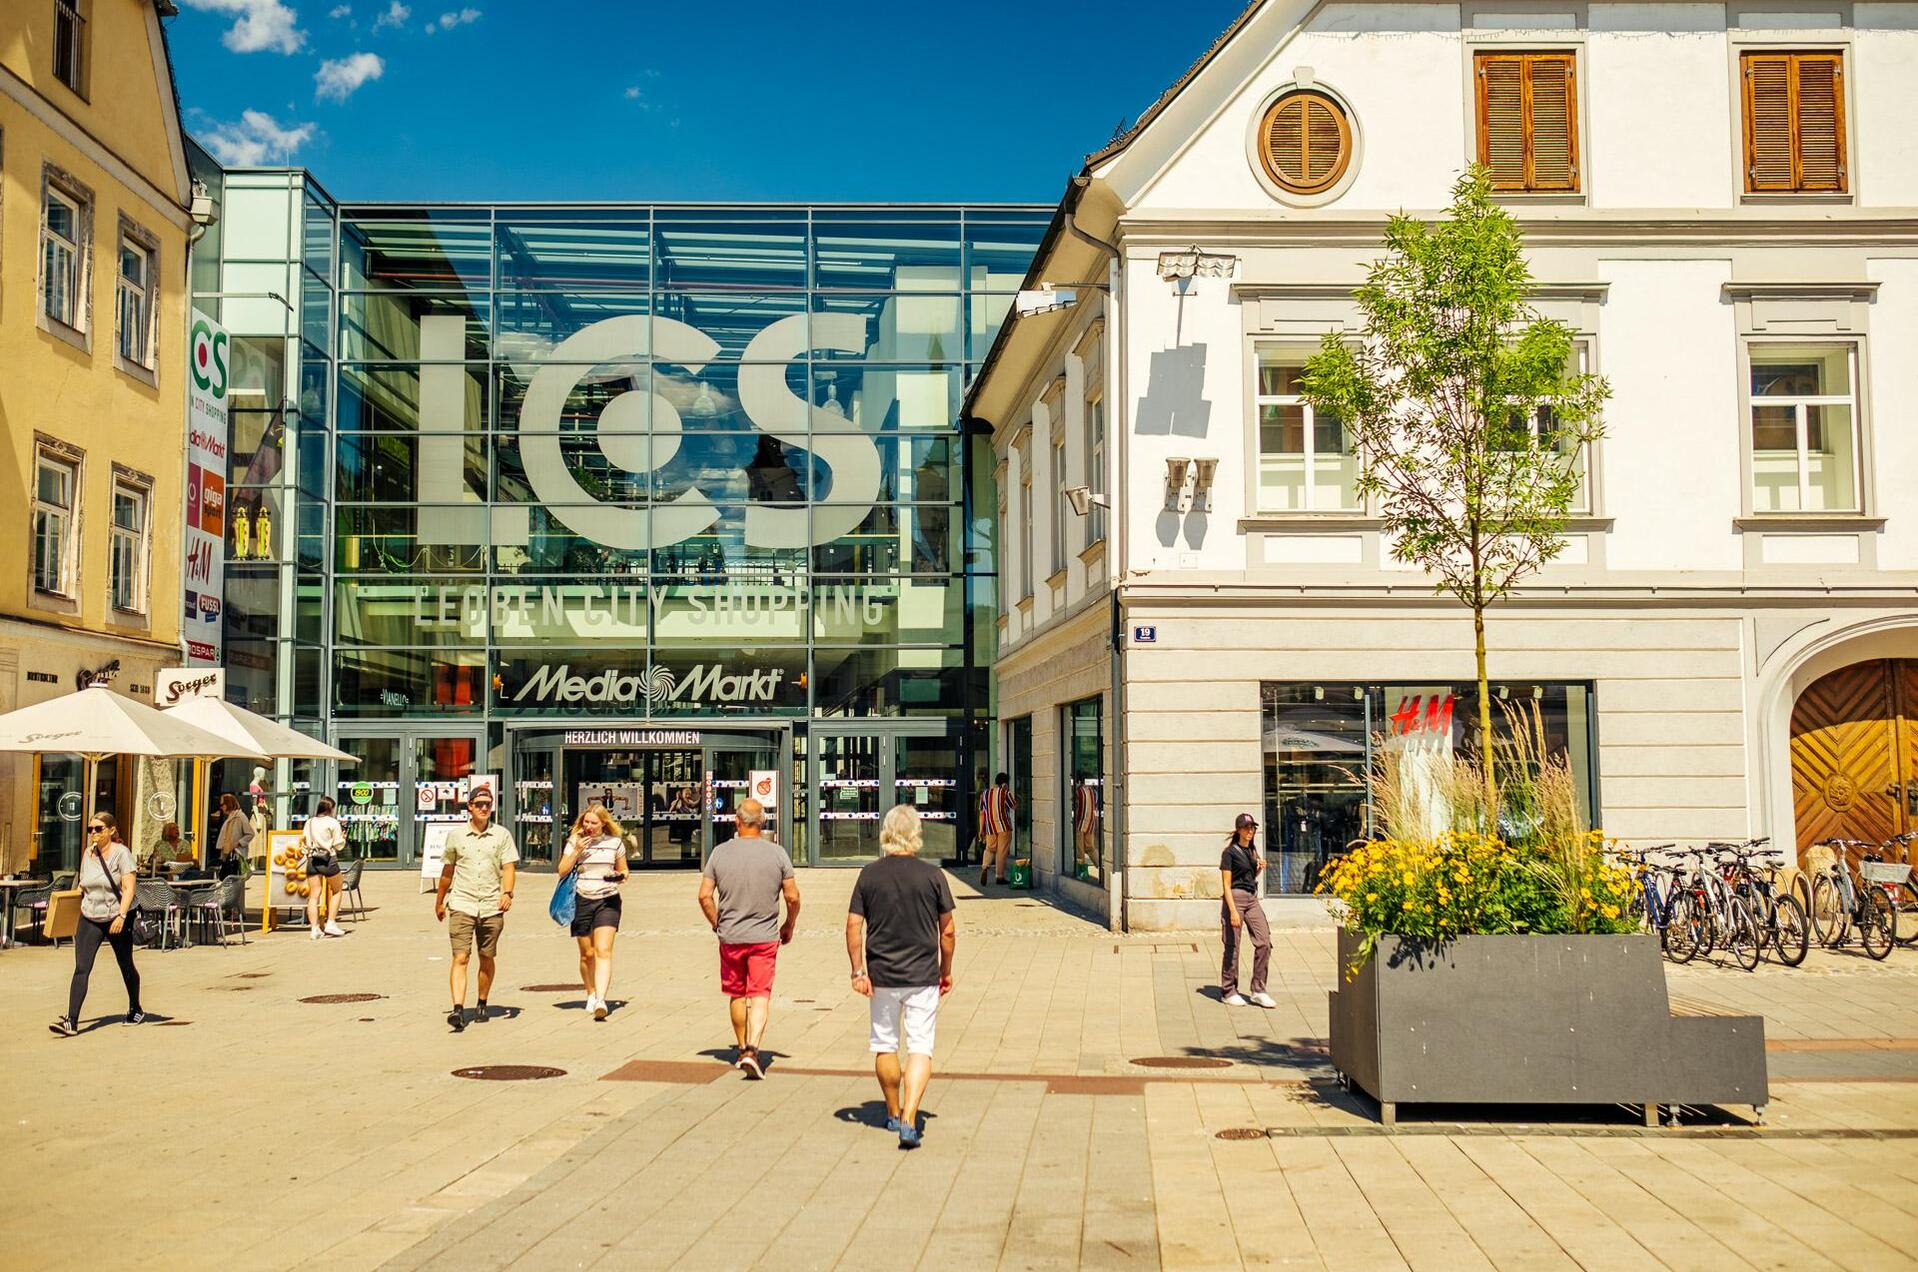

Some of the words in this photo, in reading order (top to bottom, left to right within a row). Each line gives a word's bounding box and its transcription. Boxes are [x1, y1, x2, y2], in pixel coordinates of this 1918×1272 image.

[191, 320, 227, 399] CS
[417, 312, 881, 549] LCS
[204, 486, 222, 507] giga
[187, 536, 212, 585] H&M
[201, 597, 220, 614] FUSSL
[414, 585, 564, 628] LEOBEN
[584, 585, 667, 628] CITY
[688, 585, 884, 627] SHOPPING
[1140, 628, 1150, 637] 19
[166, 673, 217, 703] Sorger
[513, 664, 641, 701] Media
[670, 664, 782, 701] Markt
[1389, 694, 1455, 737] H&M
[18, 730, 83, 743] Sorger
[564, 730, 616, 745] HERZLICH
[620, 730, 700, 745] WILLKOMMEN
